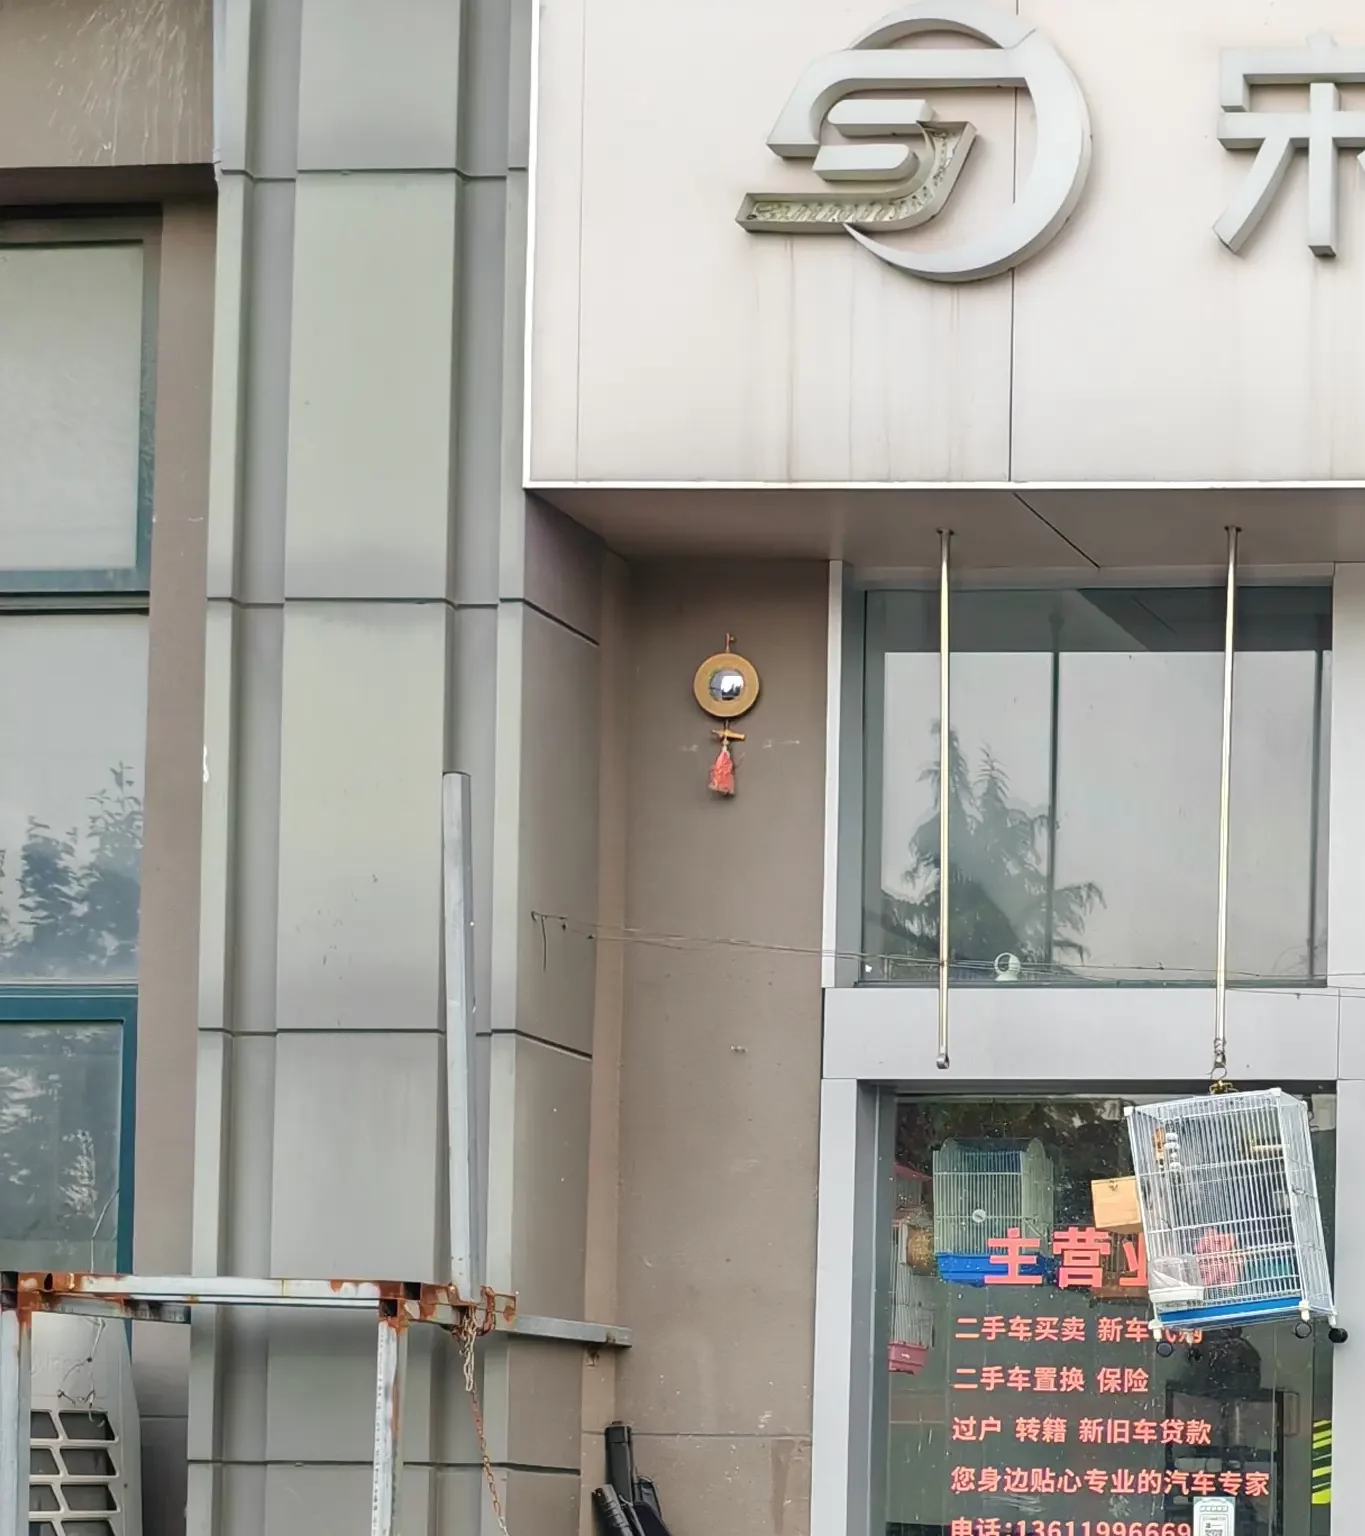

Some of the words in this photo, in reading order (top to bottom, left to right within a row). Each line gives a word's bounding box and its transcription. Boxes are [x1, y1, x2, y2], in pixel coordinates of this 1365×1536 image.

[954, 1315, 1086, 1343] 二手车买卖
[952, 1366, 1085, 1393] 二手车置换
[1097, 1367, 1150, 1394] 保险
[951, 1416, 1002, 1442] 过户
[1015, 1417, 1067, 1444] 转籍
[1078, 1418, 1212, 1445] 新旧车贷款
[950, 1465, 1271, 1497] 您身边贴心专业的汽车专家
